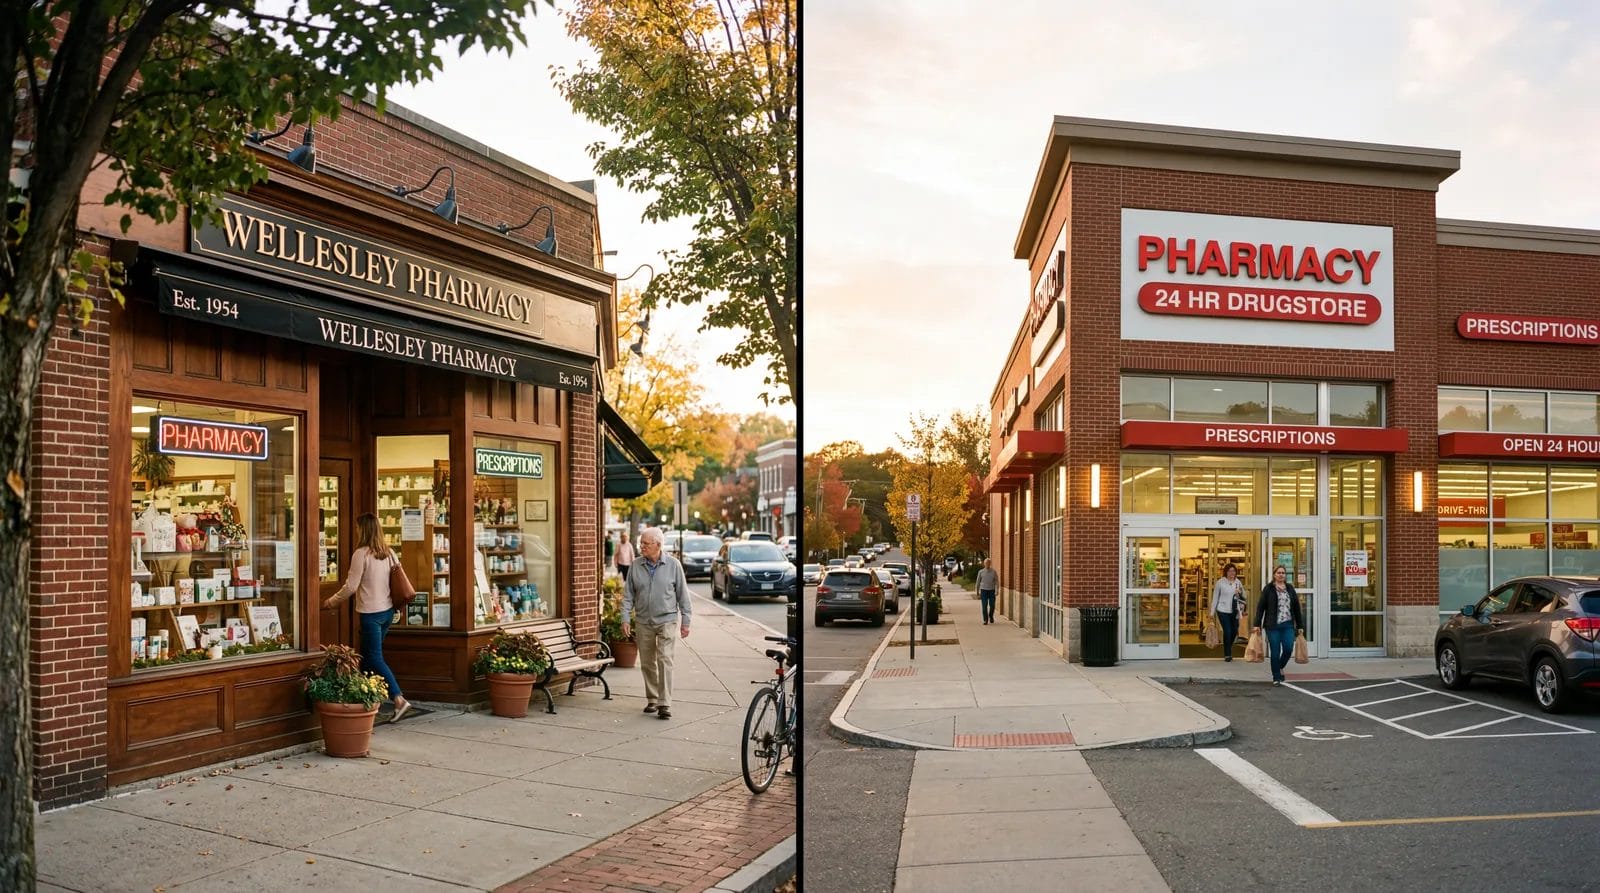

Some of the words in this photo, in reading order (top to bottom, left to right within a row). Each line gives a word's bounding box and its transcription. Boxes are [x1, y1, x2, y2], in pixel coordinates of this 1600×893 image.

[220, 207, 399, 288] WELLESLEY
[407, 262, 534, 324] PHARMACY
[1138, 235, 1380, 285] PHARMACY
[172, 289, 200, 311] Est.
[206, 297, 239, 319] 1954
[1155, 289, 1181, 308] 24
[1188, 290, 1220, 310] HR
[1228, 292, 1367, 318] DRUGSTORE
[1466, 318, 1599, 339] PRESCRIPTIONS
[318, 317, 426, 359] WELLESLEY
[430, 341, 517, 377] PHARMACY
[572, 374, 588, 388] 1954
[162, 423, 264, 454] PHARMACY
[1205, 428, 1336, 445] PRESCRIPTIONS
[1503, 438, 1543, 452] OPEN
[1547, 440, 1563, 452] 24
[1567, 440, 1600, 453] HOU
[478, 453, 542, 474] PRESCRIPTIONS
